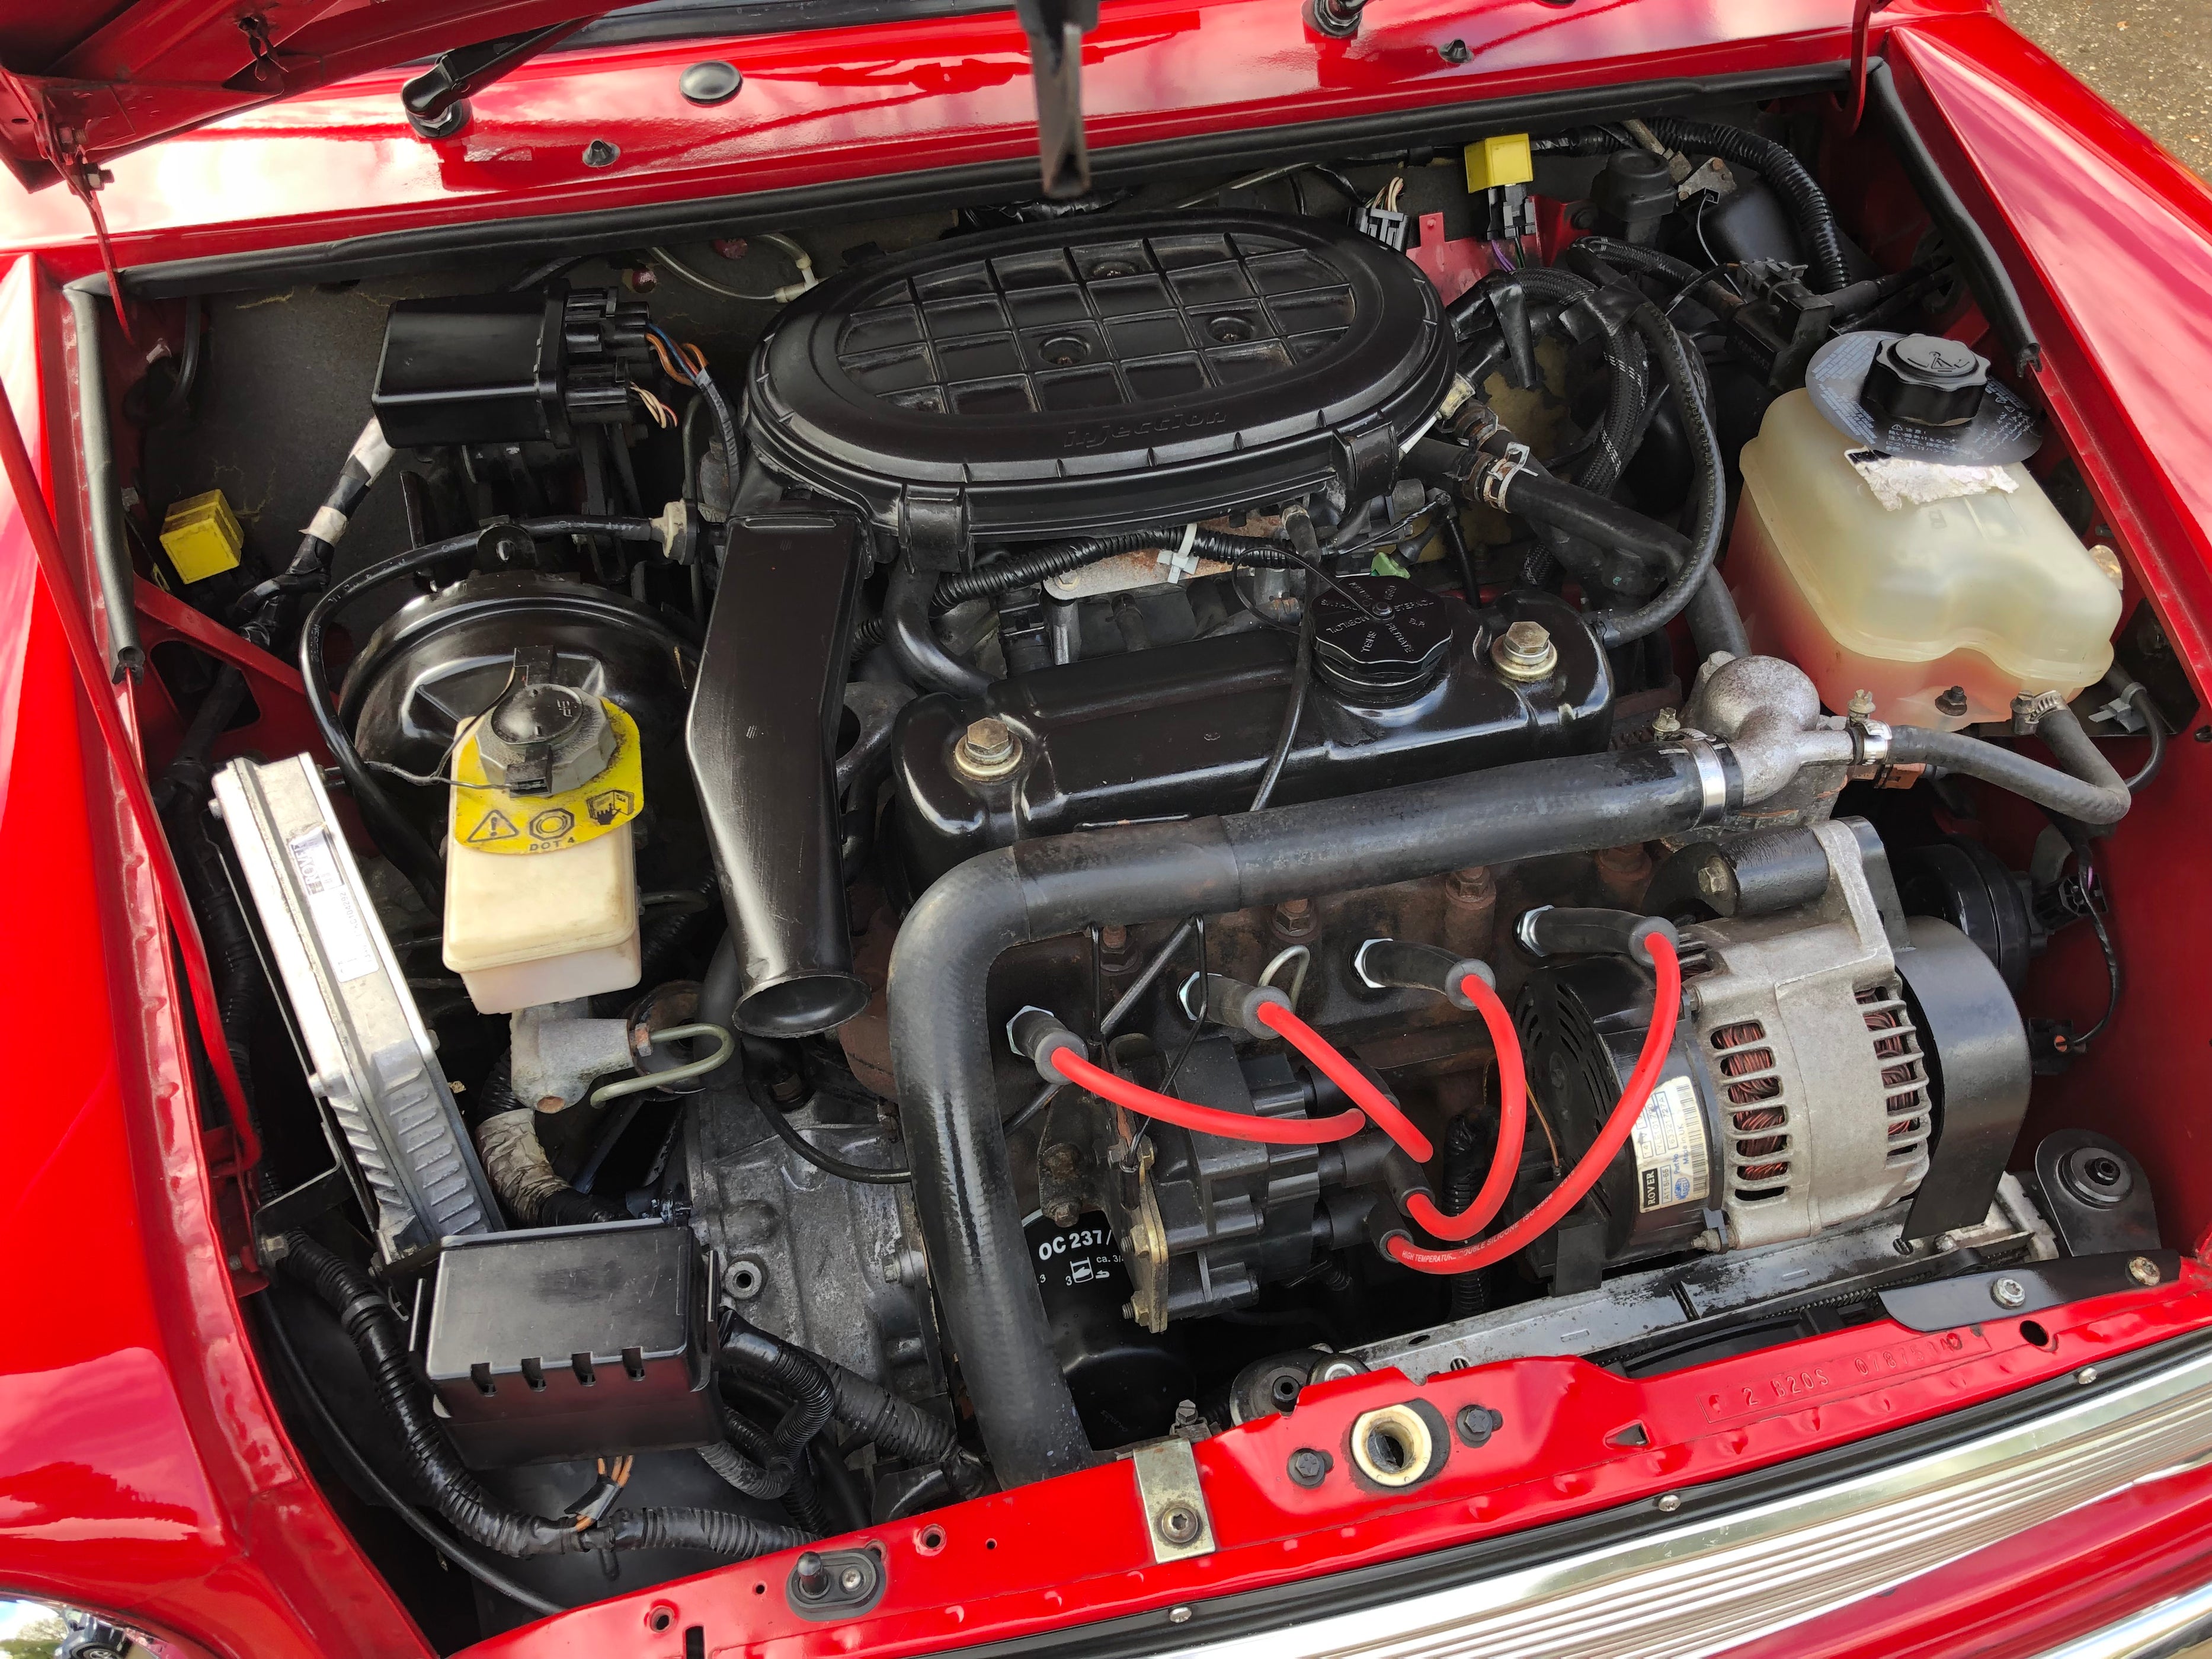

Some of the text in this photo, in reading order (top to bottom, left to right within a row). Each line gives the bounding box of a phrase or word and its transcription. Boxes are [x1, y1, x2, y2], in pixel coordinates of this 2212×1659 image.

[1064, 412, 1226, 448] injection
[1326, 614, 1370, 634] MOBILOIL
[530, 840, 561, 851] DOT
[1677, 1123, 1686, 1136] UK
[1682, 1135, 1688, 1145] in
[1673, 1153, 1679, 1163] No
[1646, 1170, 1657, 1206] ROVER
[1039, 1237, 1066, 1260] OC
[1402, 1251, 1414, 1261] HIGH
[1414, 1253, 1457, 1264] TEMPERATURE
[1487, 1222, 1519, 1246] SILICONE
[1742, 1387, 1758, 1407] 2
